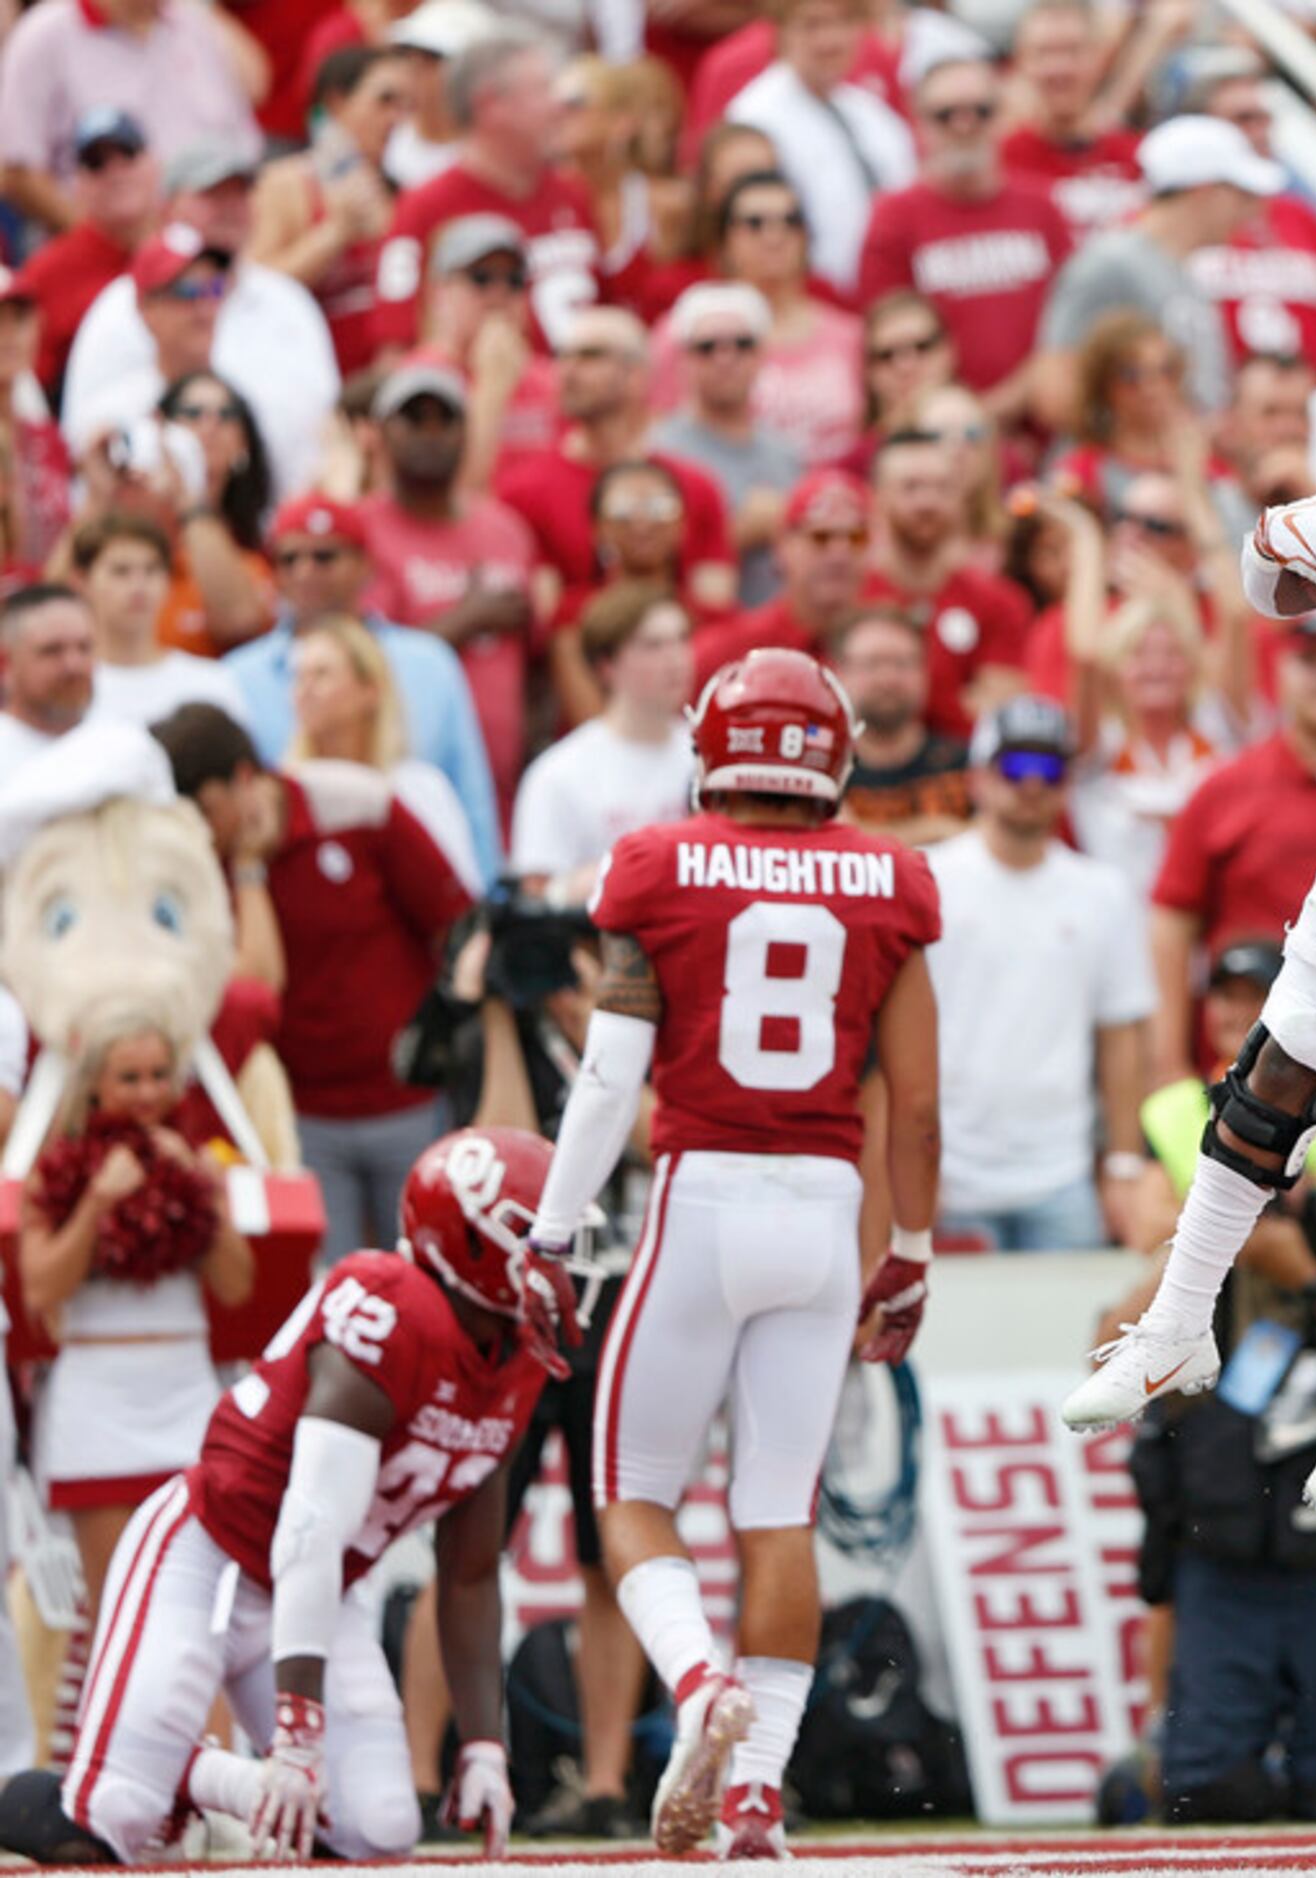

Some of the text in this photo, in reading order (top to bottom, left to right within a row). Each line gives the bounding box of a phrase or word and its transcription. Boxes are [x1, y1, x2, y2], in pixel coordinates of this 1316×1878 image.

[779, 723, 805, 760] 8
[677, 841, 895, 899] HAUGHTON
[717, 899, 848, 1092] 8
[321, 1276, 397, 1366] 42
[941, 1404, 1106, 1806] DEFENSE
